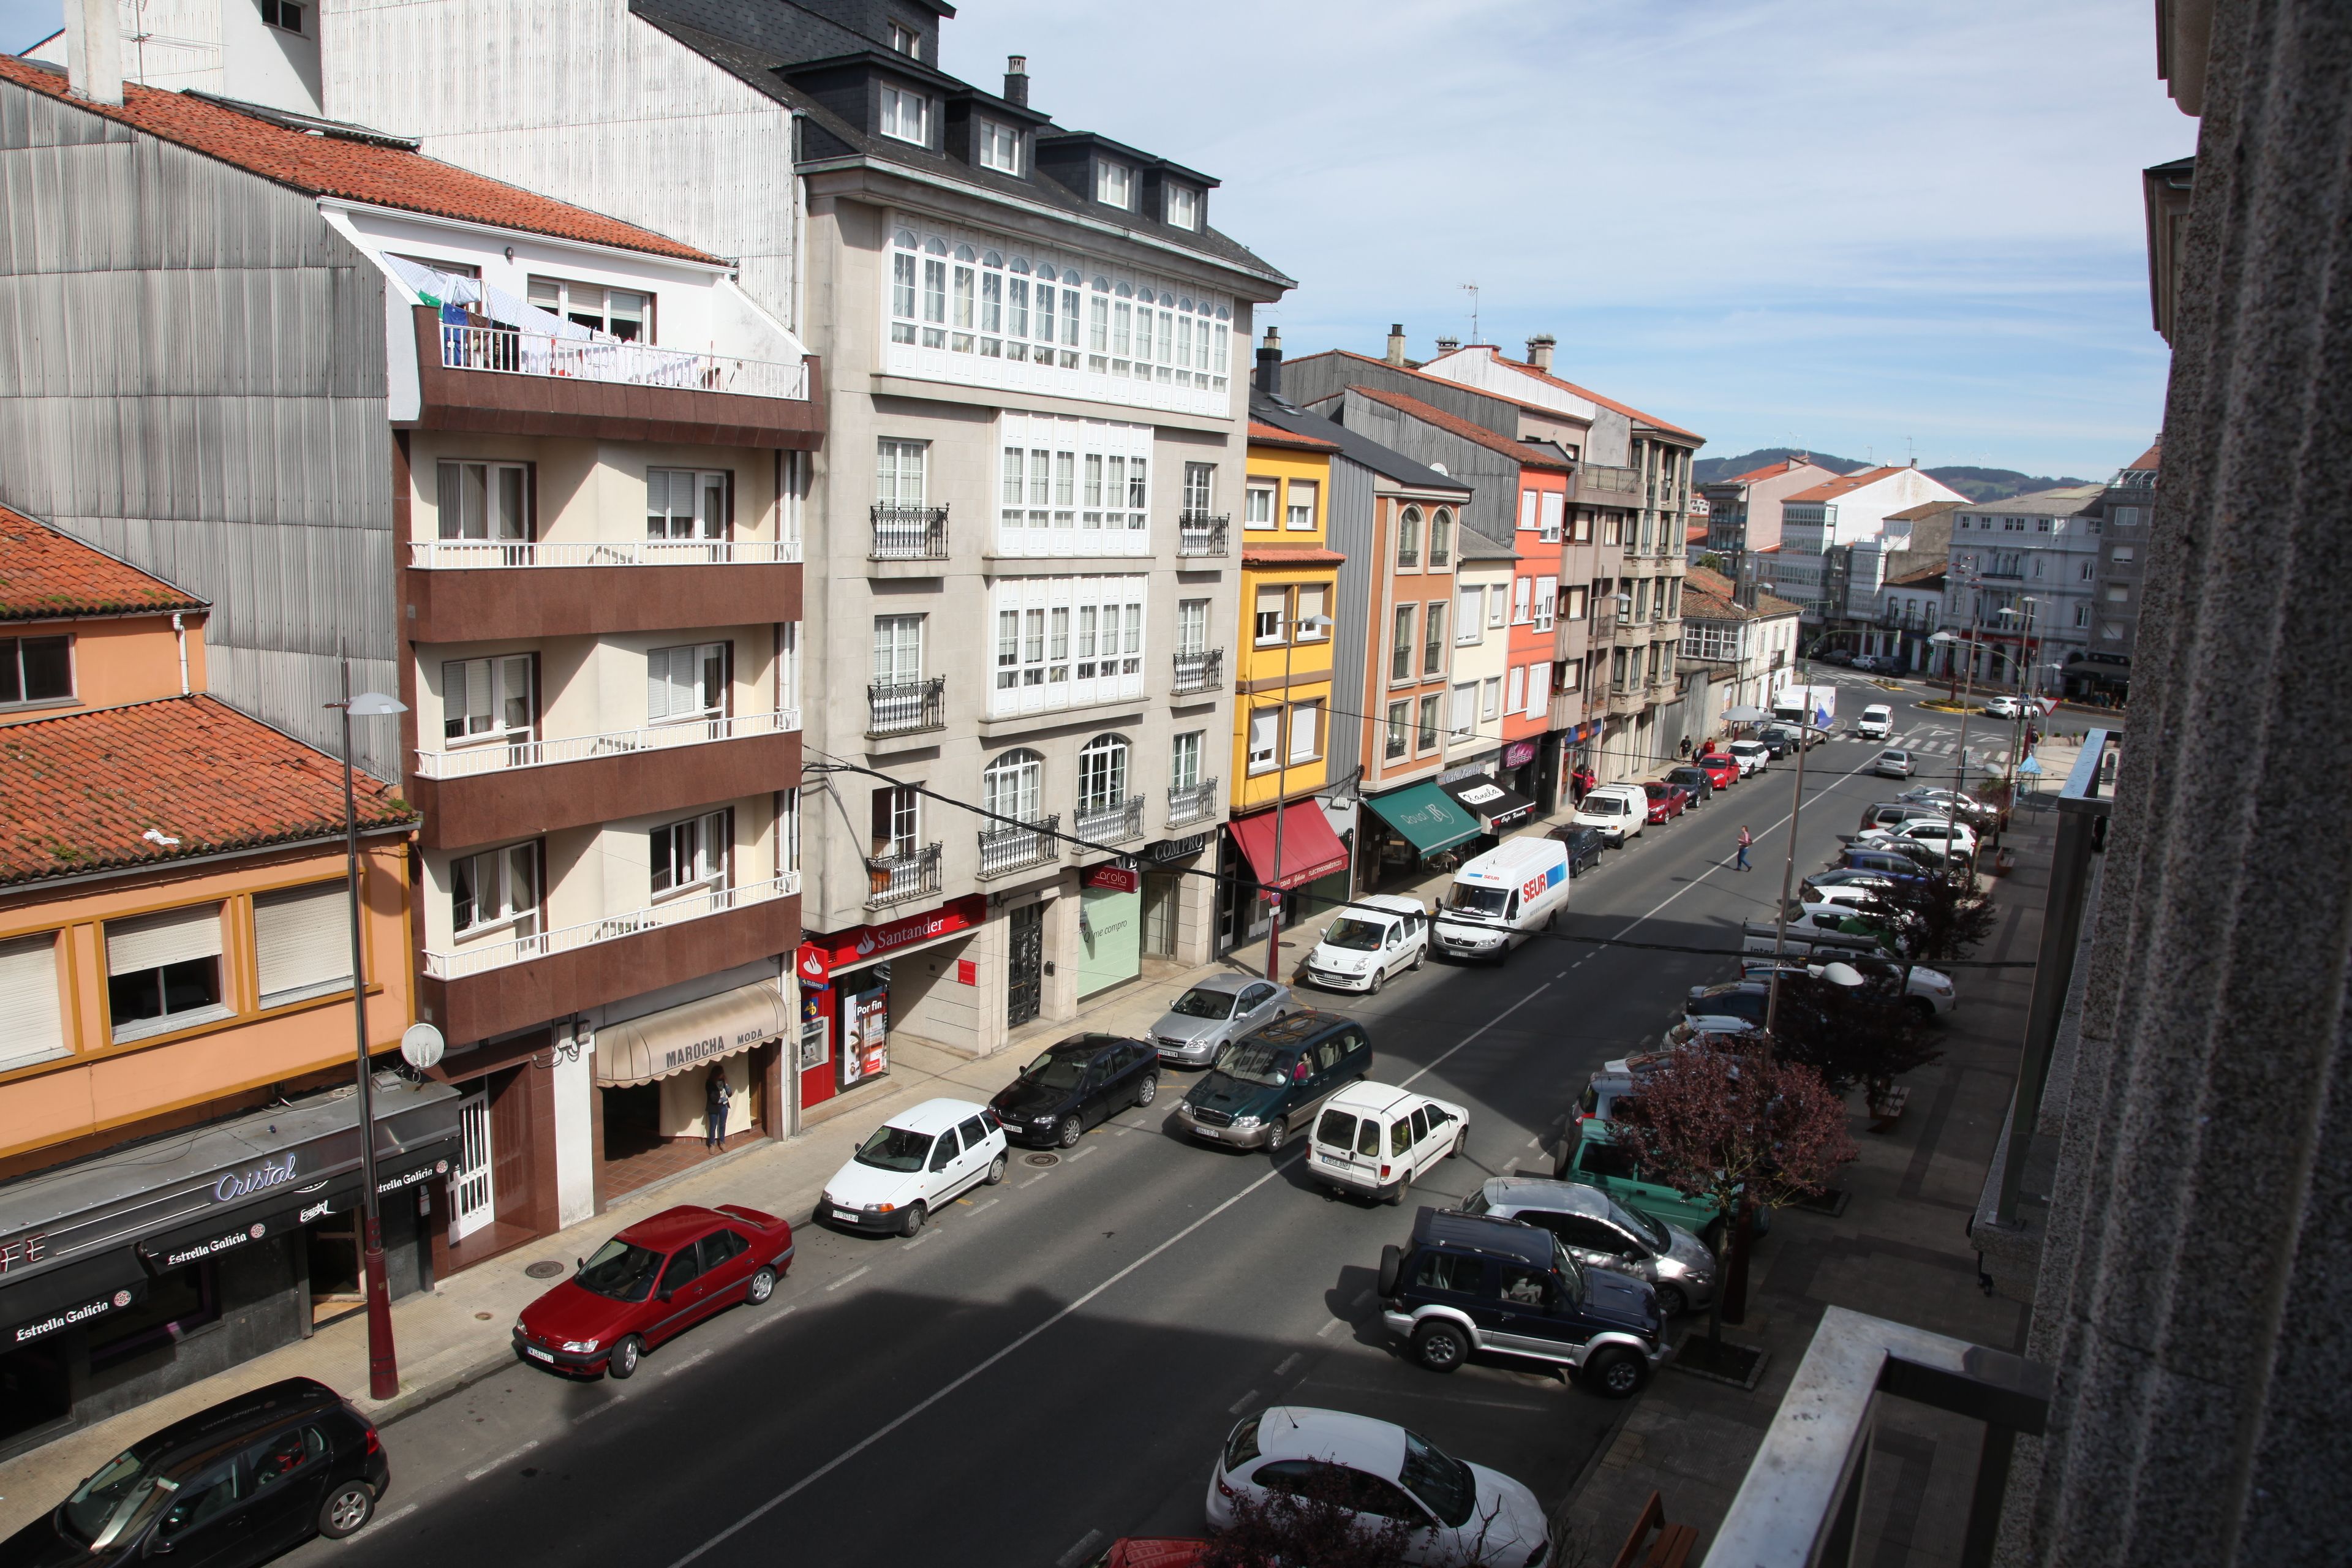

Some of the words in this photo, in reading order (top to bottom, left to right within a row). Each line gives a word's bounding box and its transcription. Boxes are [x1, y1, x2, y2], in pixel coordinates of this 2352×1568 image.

[1155, 833, 1203, 861] COMPRO
[1523, 873, 1547, 903] SEUR
[877, 916, 944, 949] Santander
[1104, 920, 1128, 935] compro
[807, 980, 824, 989] TELEBANCO
[857, 1004, 870, 1016] Por
[872, 1000, 882, 1010] fin
[666, 1035, 725, 1068] MAROCHA
[737, 1028, 763, 1045] MODA
[216, 1152, 296, 1201] Cristal
[377, 1180, 402, 1195] strella
[403, 1167, 433, 1185] Galicia
[300, 1199, 337, 1224] Cristal
[167, 1246, 209, 1265] Estrella
[209, 1232, 247, 1252] Galicia
[16, 1317, 66, 1341] Estrella
[66, 1301, 109, 1323] Galicia
